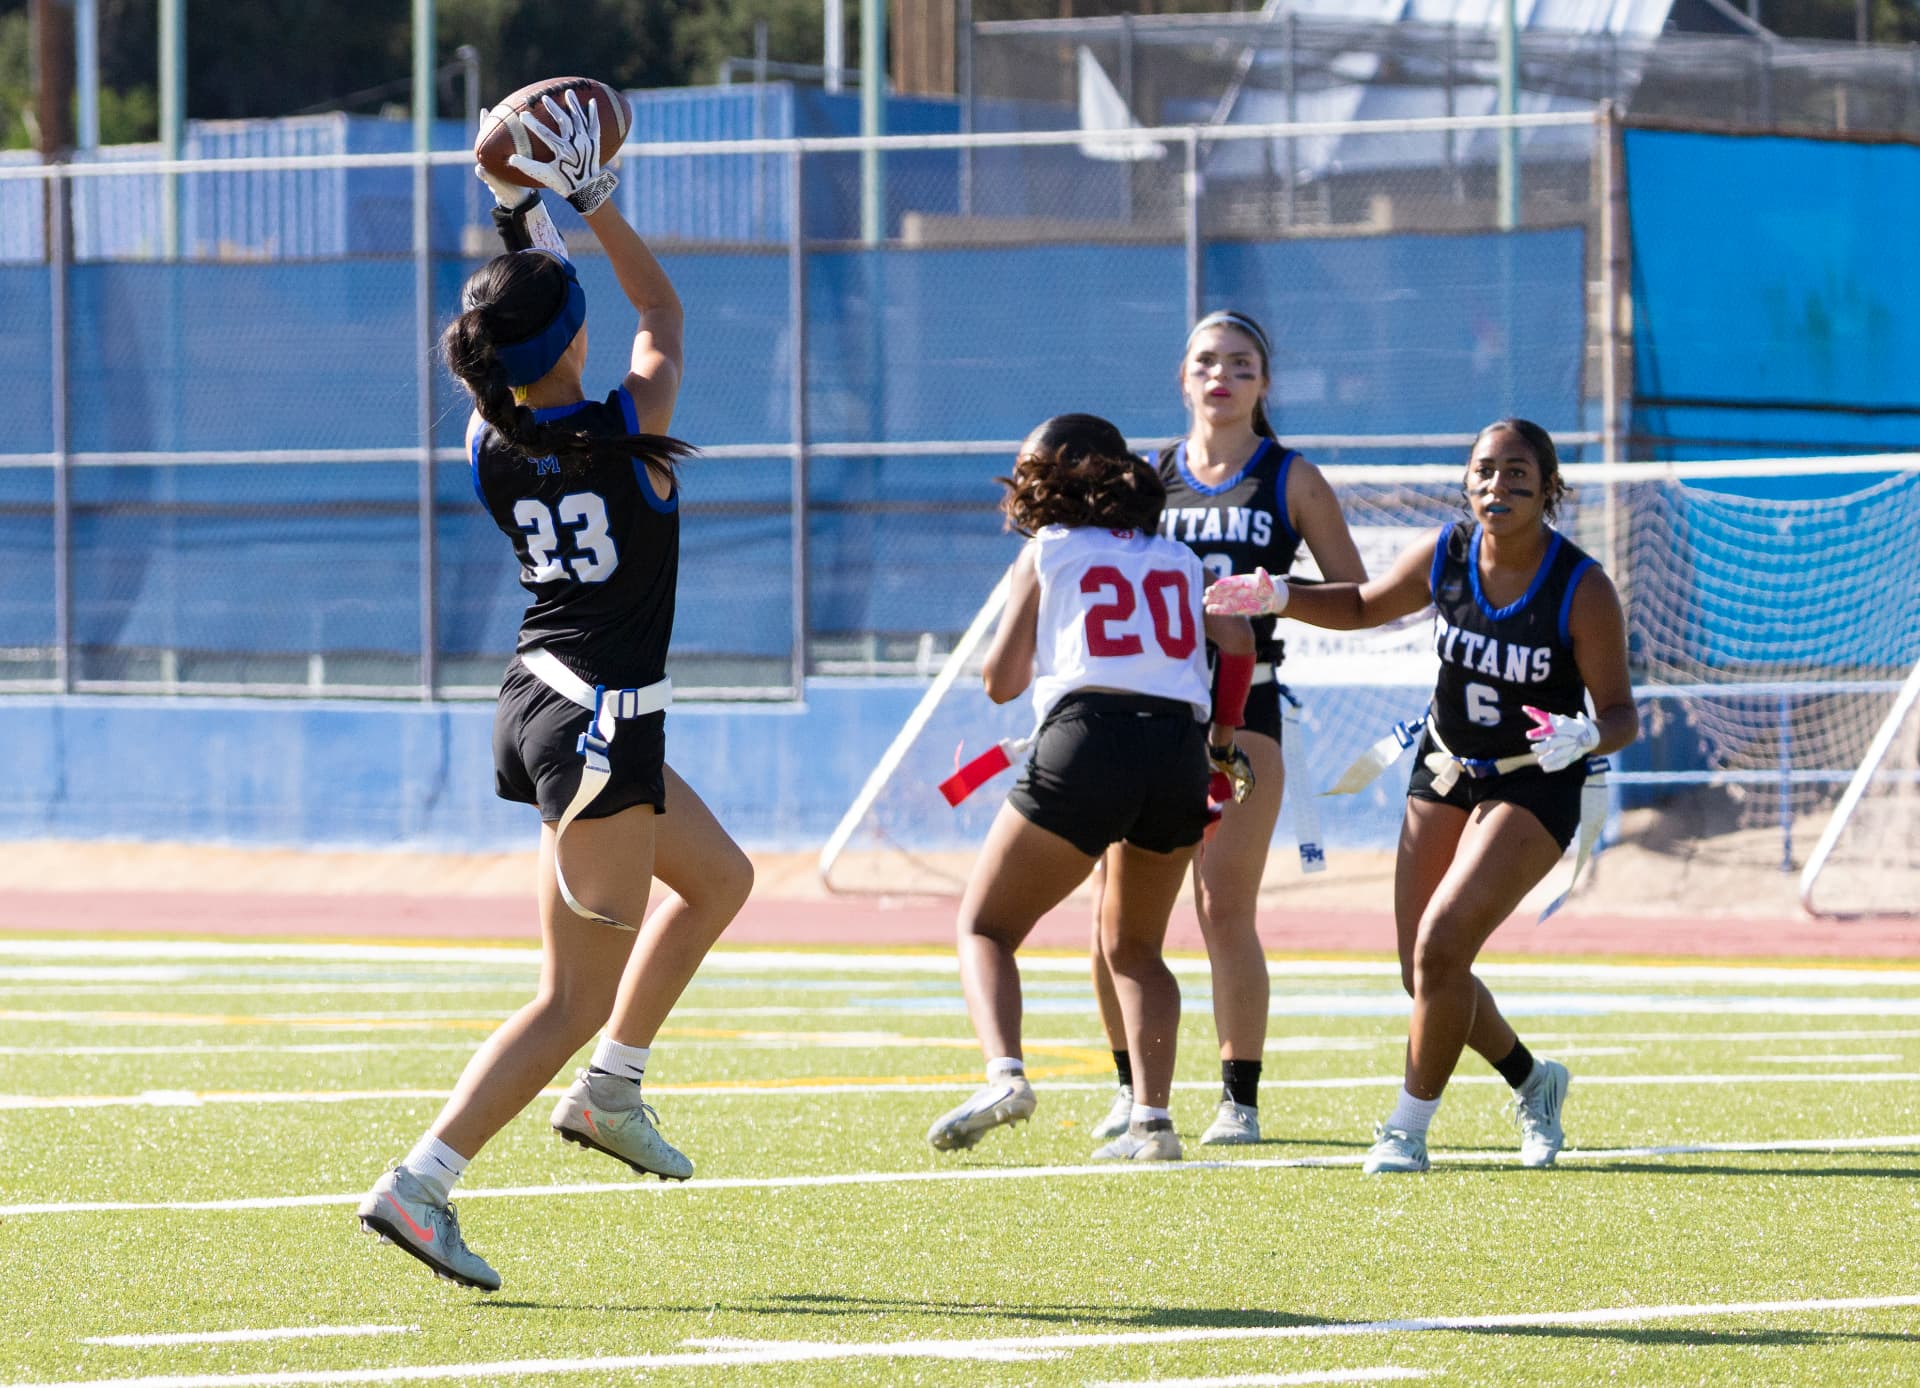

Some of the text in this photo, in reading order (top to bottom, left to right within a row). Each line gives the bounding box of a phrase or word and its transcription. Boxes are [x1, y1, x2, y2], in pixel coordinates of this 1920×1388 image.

[512, 491, 620, 583] 23
[1160, 506, 1273, 546] ITANS
[1080, 565, 1197, 660] 20
[1435, 613, 1551, 683] TITANS
[1465, 682, 1501, 727] 6
